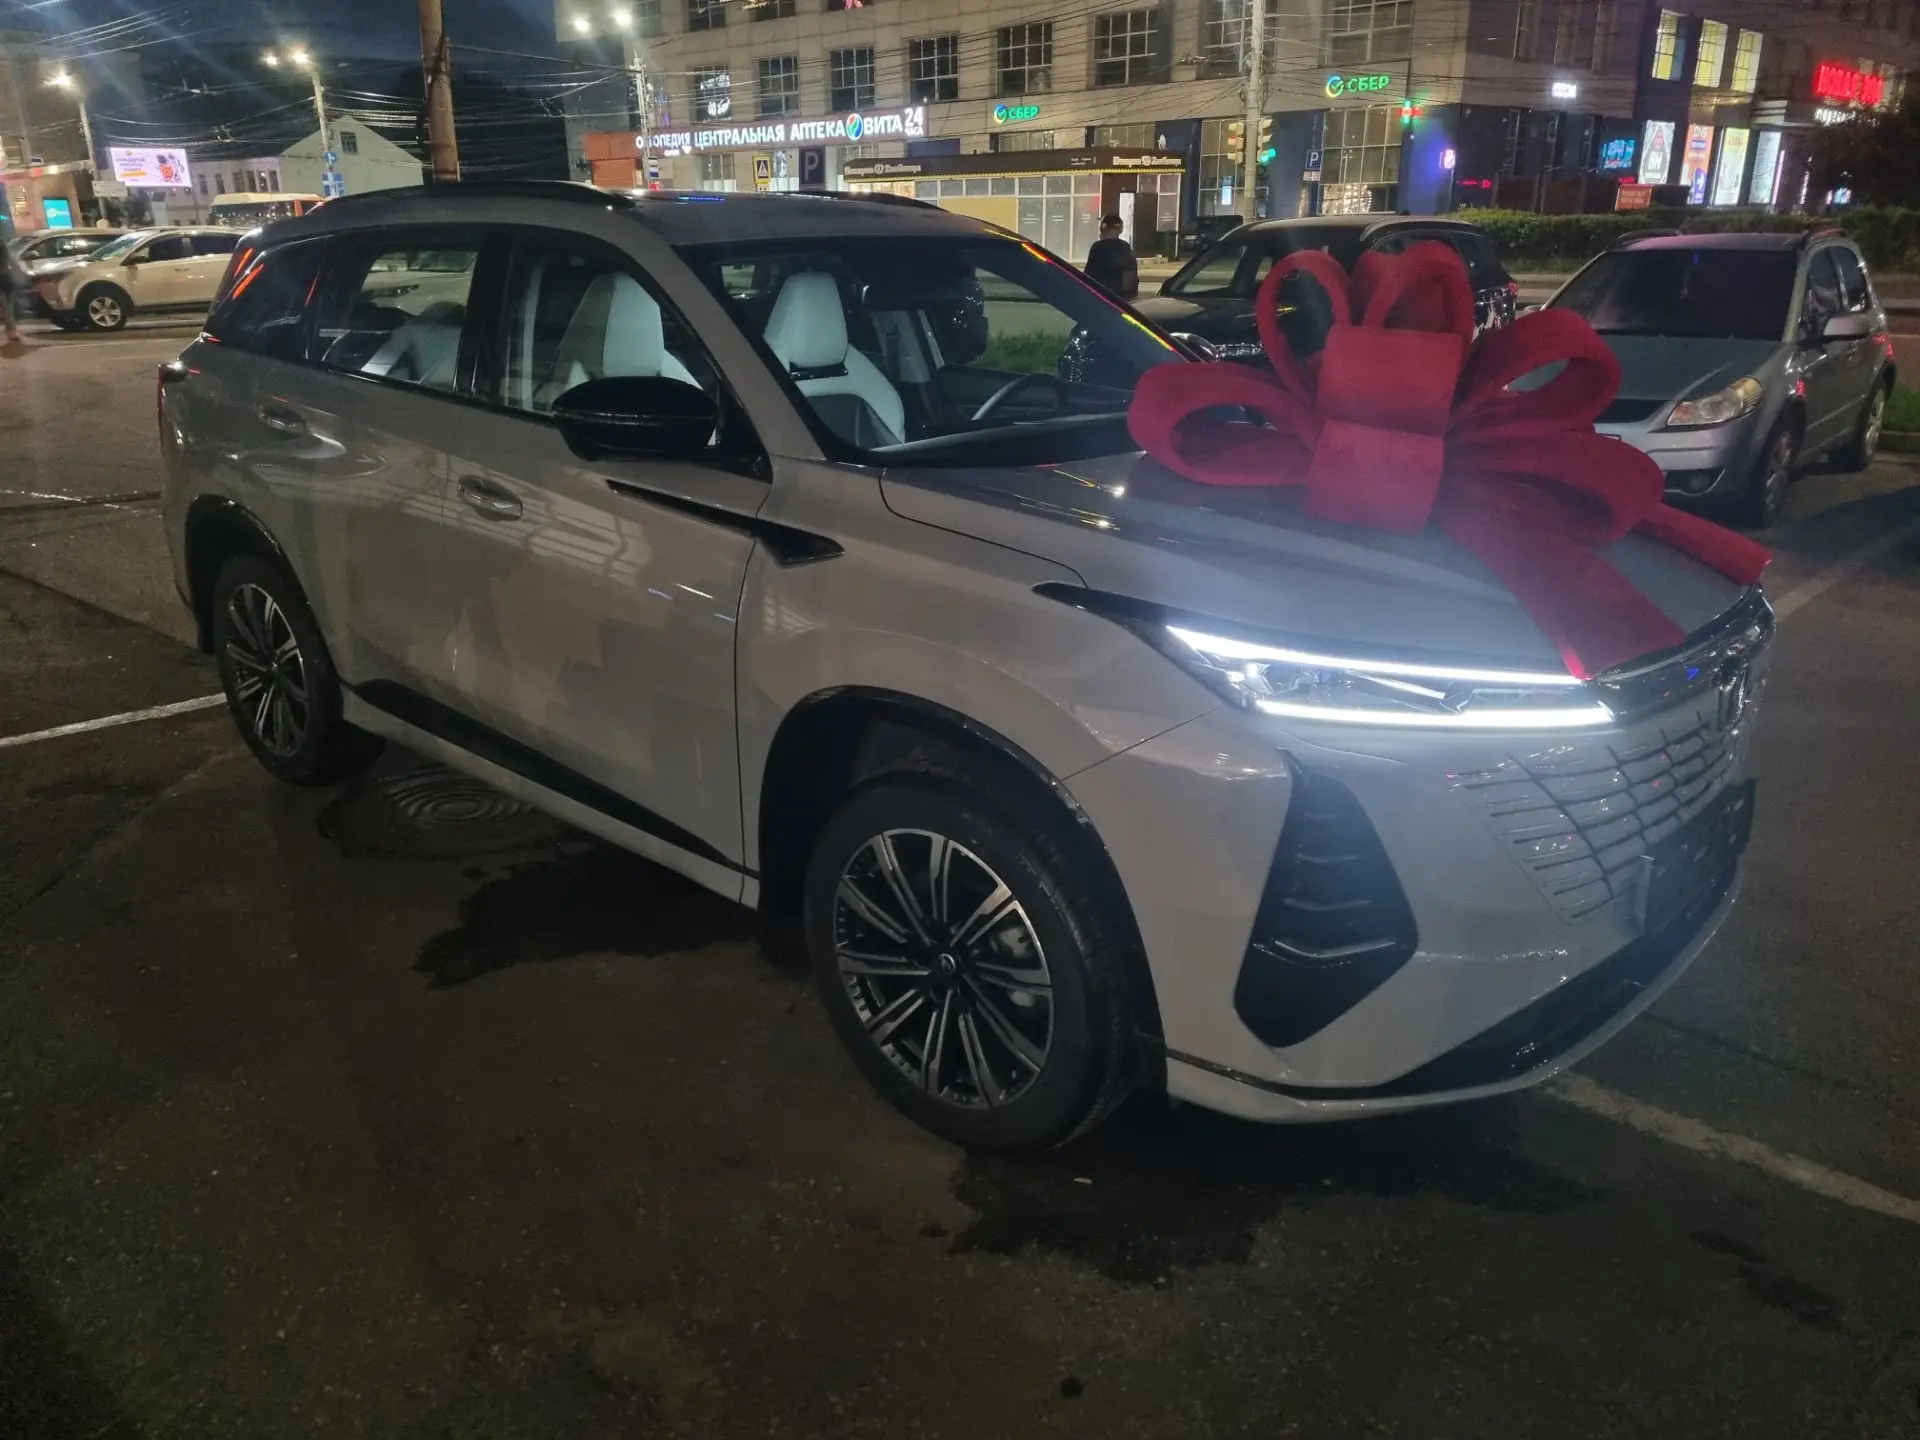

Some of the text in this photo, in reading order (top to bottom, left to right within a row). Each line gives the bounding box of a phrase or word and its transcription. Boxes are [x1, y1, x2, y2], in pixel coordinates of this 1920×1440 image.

[1347, 75, 1390, 93] СБЕР
[904, 106, 924, 126] 24
[1008, 105, 1040, 119] СБЕР
[635, 114, 903, 149] ОТОПЕДИЯ ЦЕНТРАЛЬНАЯ АПТЕКА ВИТА
